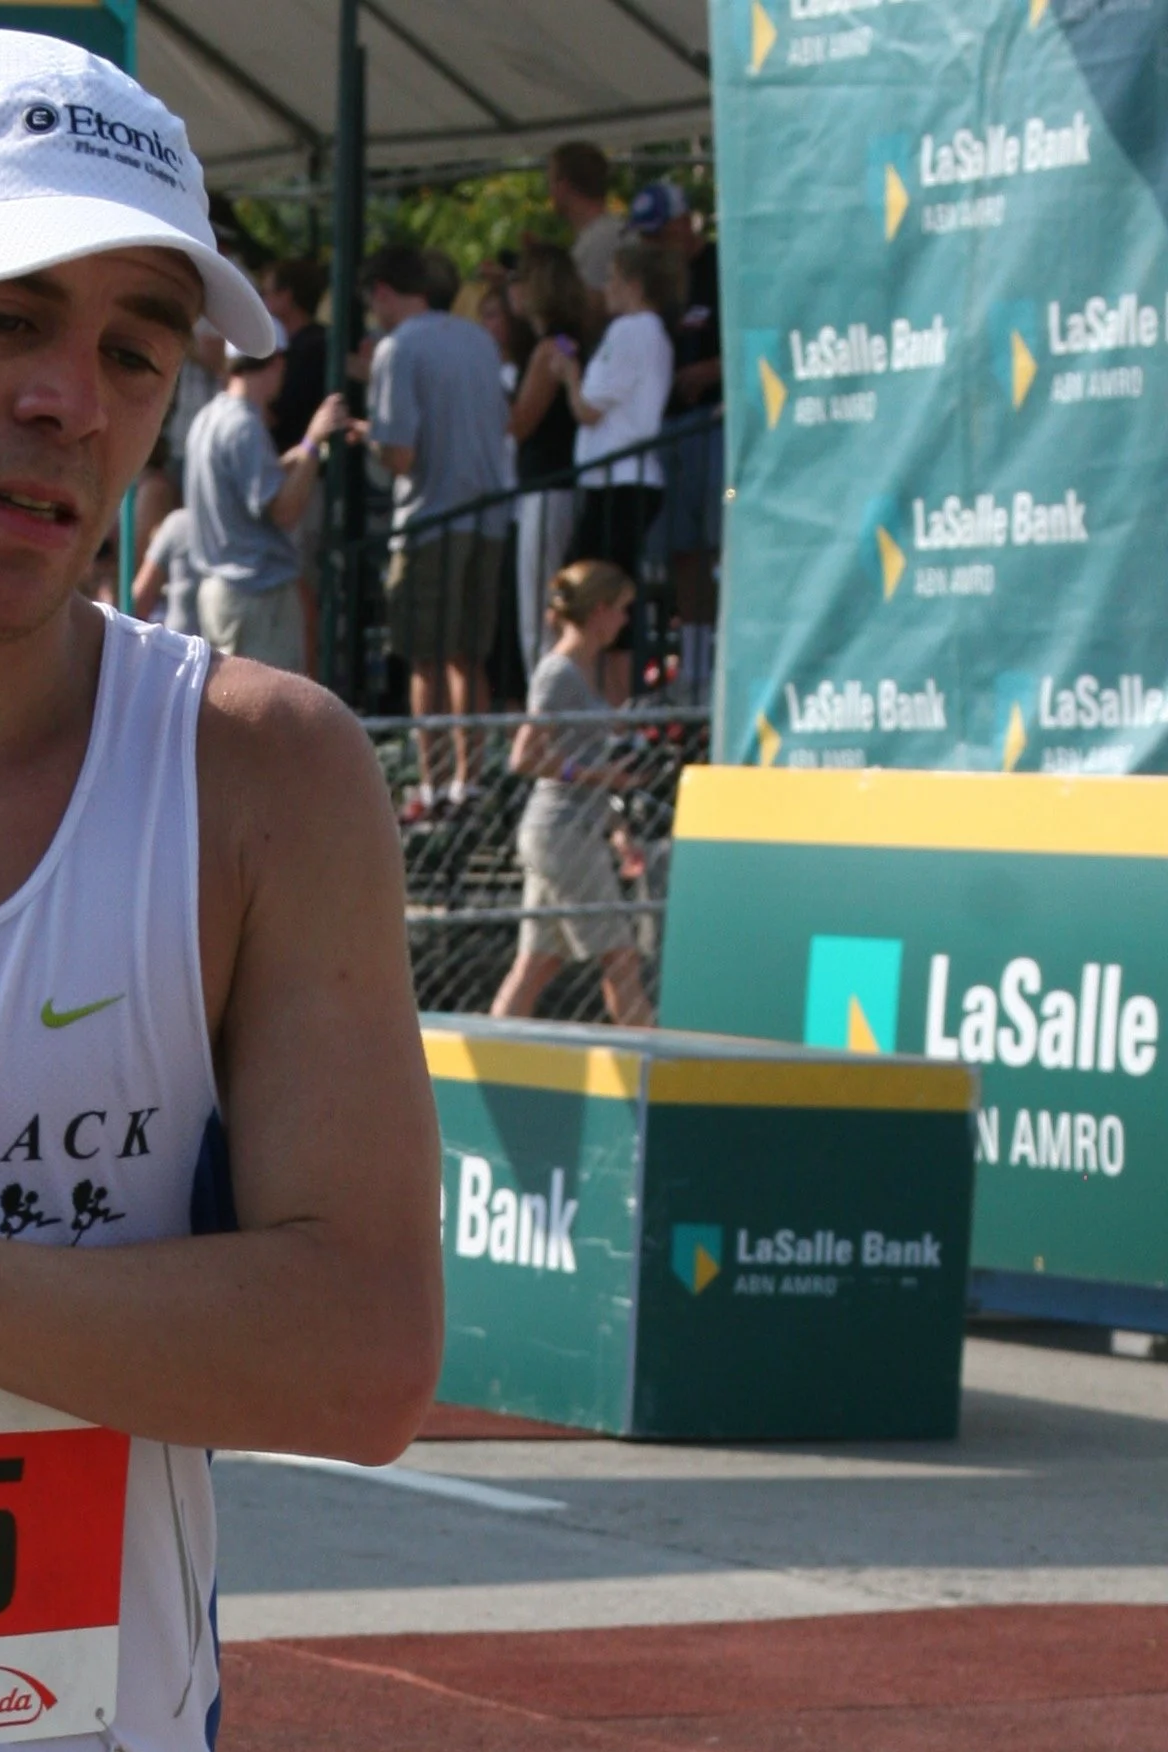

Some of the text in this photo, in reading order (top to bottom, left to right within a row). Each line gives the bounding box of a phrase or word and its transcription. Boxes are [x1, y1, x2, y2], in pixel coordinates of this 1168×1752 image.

[63, 103, 180, 174] Etonic
[920, 109, 1091, 188] LaSalle Bank
[790, 314, 949, 380] LaSalle Bank
[1049, 293, 1159, 356] LaSalle
[912, 489, 1089, 551] LaSalle Bank
[786, 676, 948, 733] LaSalle Bank
[1039, 673, 1162, 730] LaSalle
[925, 953, 1159, 1077] LaSalle
[1009, 1107, 1125, 1177] AMRO
[455, 1155, 580, 1274] Bank
[736, 1228, 942, 1267] LaSalle Bank
[734, 1273, 838, 1297] ABN AMRO
